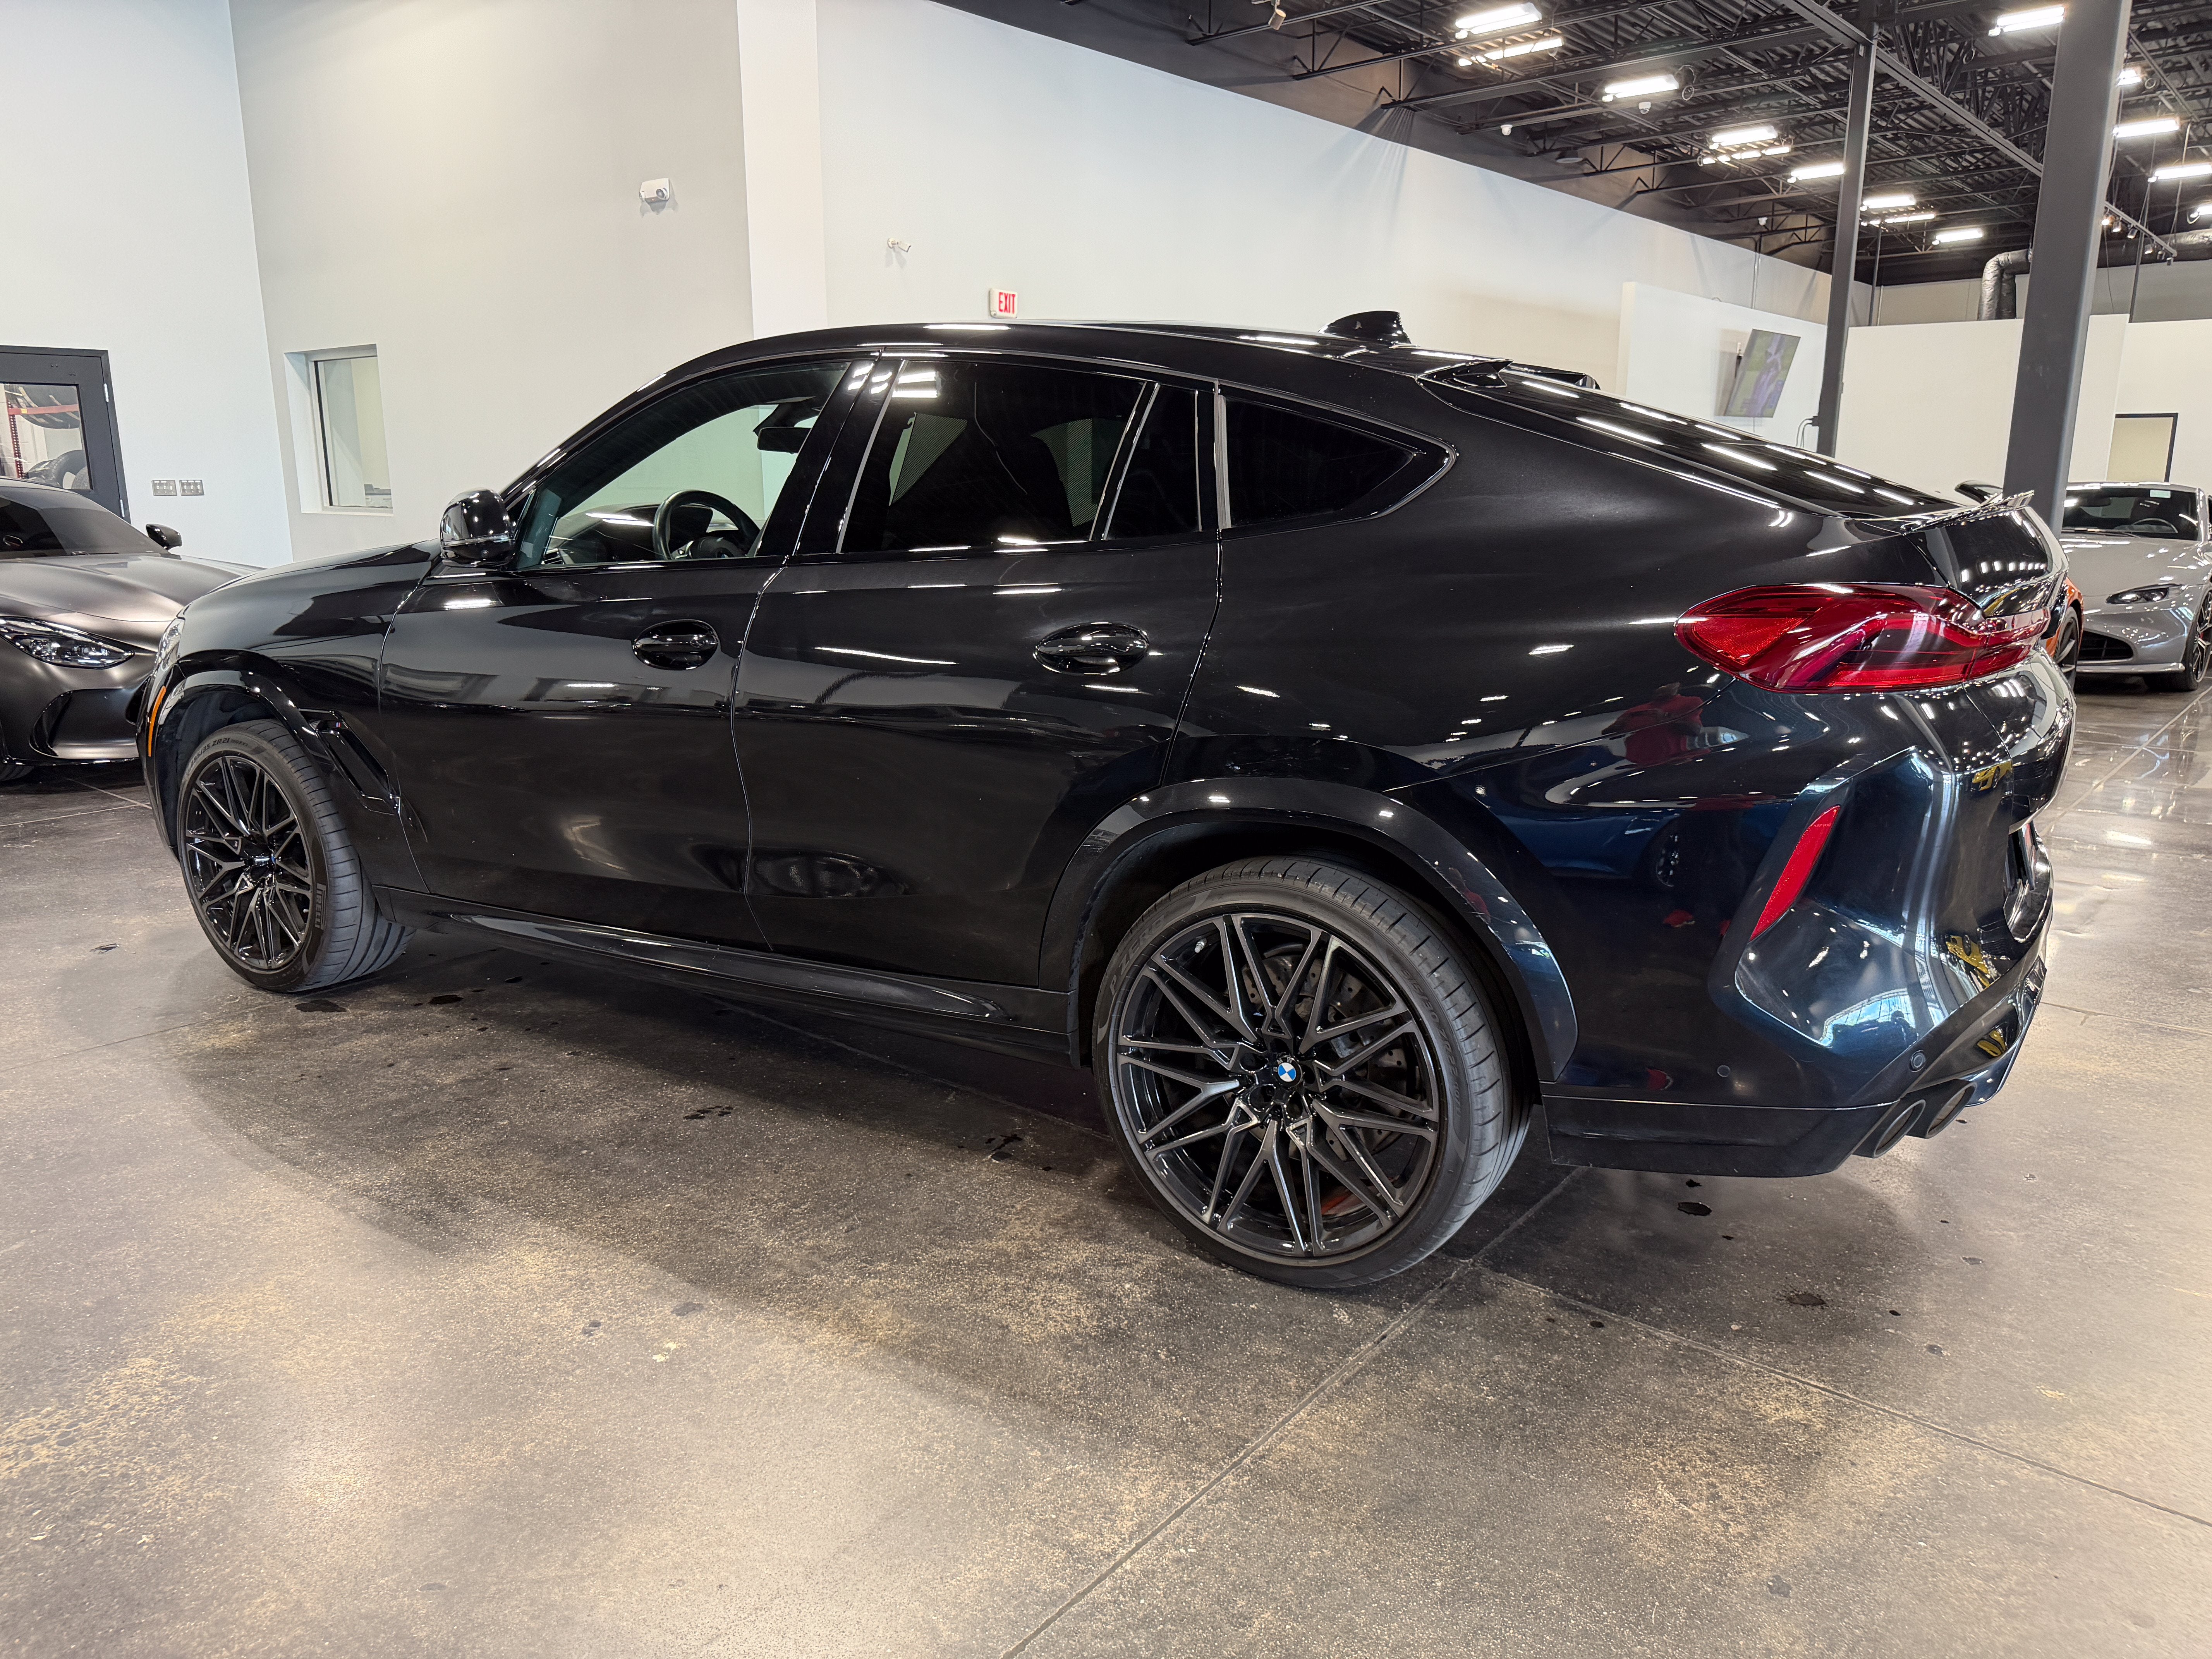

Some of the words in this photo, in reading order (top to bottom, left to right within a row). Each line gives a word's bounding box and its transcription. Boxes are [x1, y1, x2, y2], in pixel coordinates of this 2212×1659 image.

[999, 292, 1016, 314] EXIT
[211, 738, 230, 747] ZR21
[315, 883, 326, 930] PIRELLI
[1109, 975, 1117, 996] P
[1119, 915, 1165, 975] ZERO
